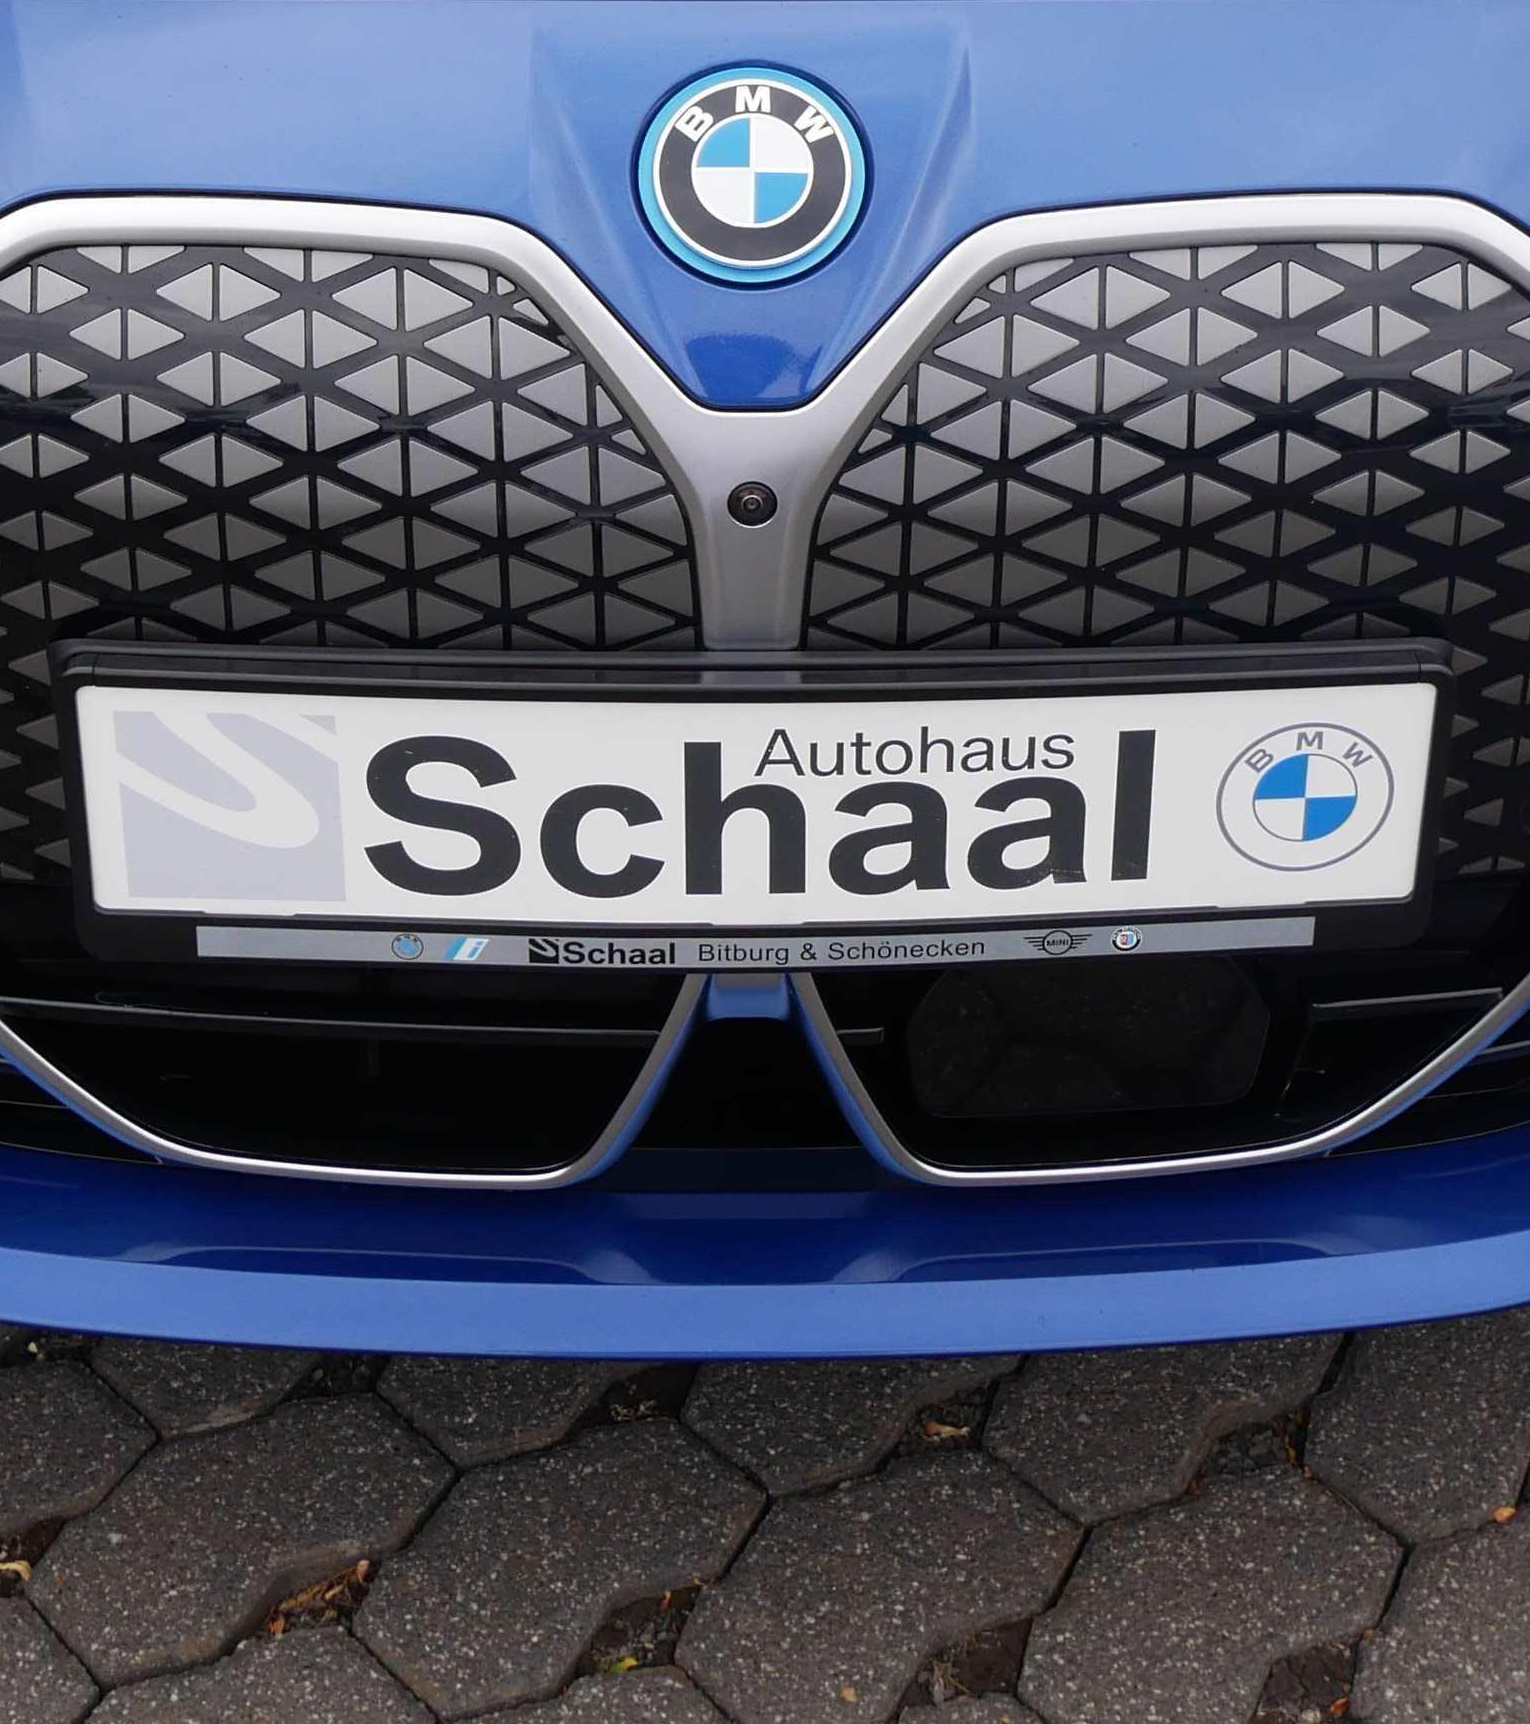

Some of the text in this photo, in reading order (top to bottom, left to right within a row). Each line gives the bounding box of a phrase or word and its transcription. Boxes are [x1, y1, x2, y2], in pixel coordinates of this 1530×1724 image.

[674, 84, 835, 144] BMW
[753, 725, 1076, 778] Autohaus
[1243, 730, 1374, 775] BMW
[363, 728, 1158, 900] Schaal
[562, 939, 986, 966] Schaal Bitburg & Schönecken
[1046, 938, 1070, 948] MINI
